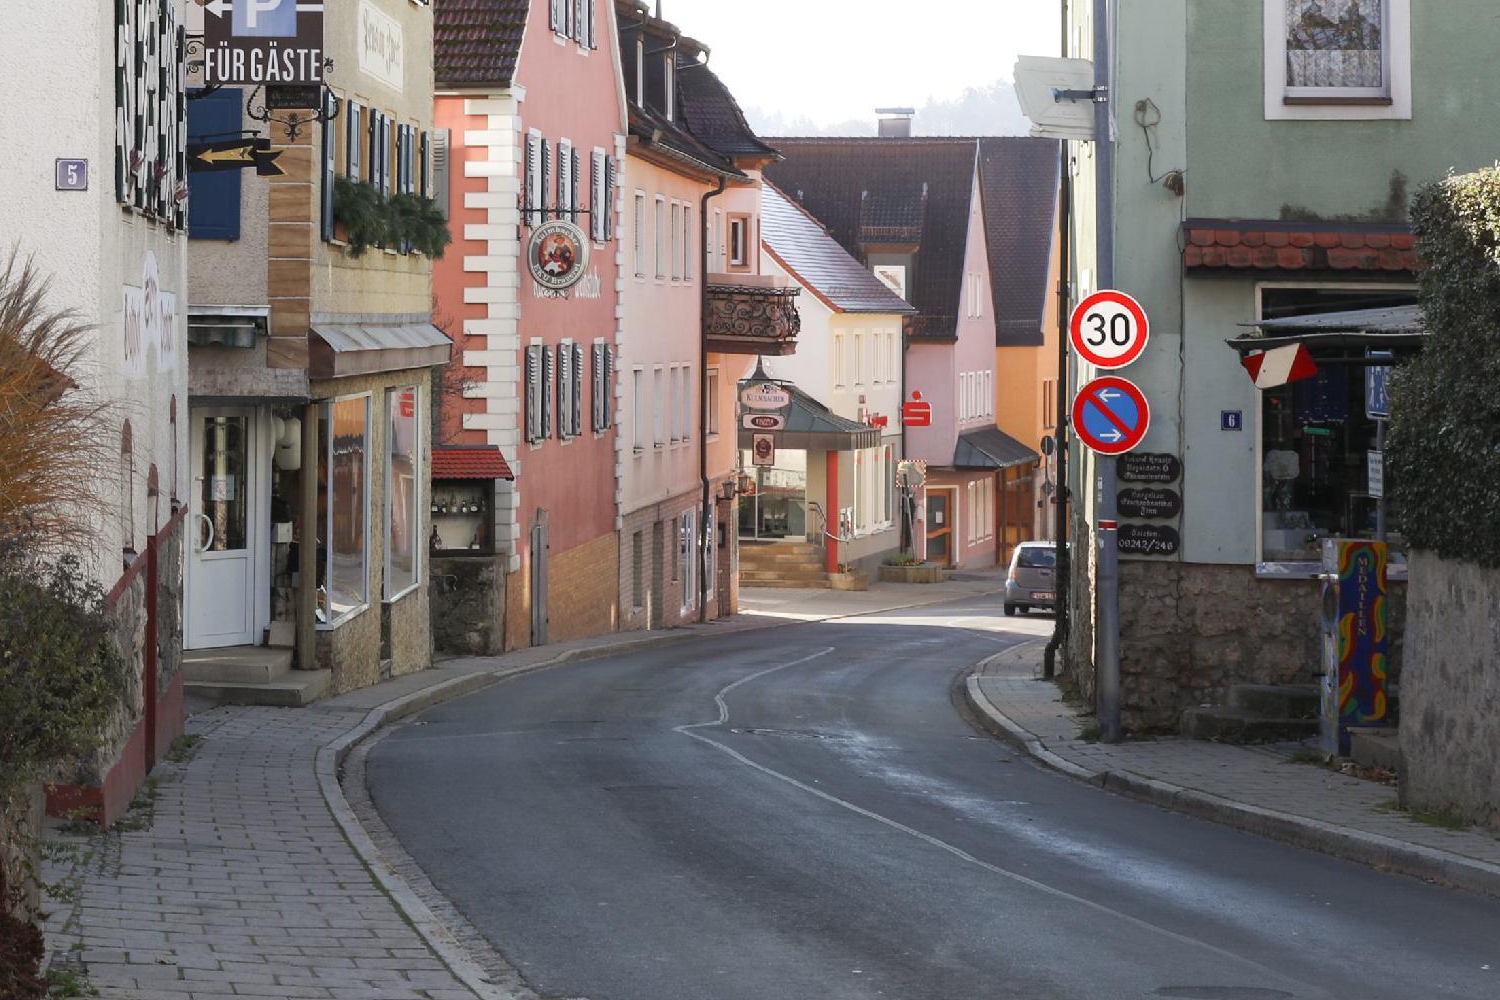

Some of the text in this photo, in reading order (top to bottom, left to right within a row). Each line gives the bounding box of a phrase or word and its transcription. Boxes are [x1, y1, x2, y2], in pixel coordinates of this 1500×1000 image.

[205, 41, 321, 82] FÜR GÄSTE
[67, 164, 78, 185] 5
[535, 225, 580, 248] Kulmbacher
[1086, 313, 1131, 346] 30
[1228, 414, 1235, 427] 6
